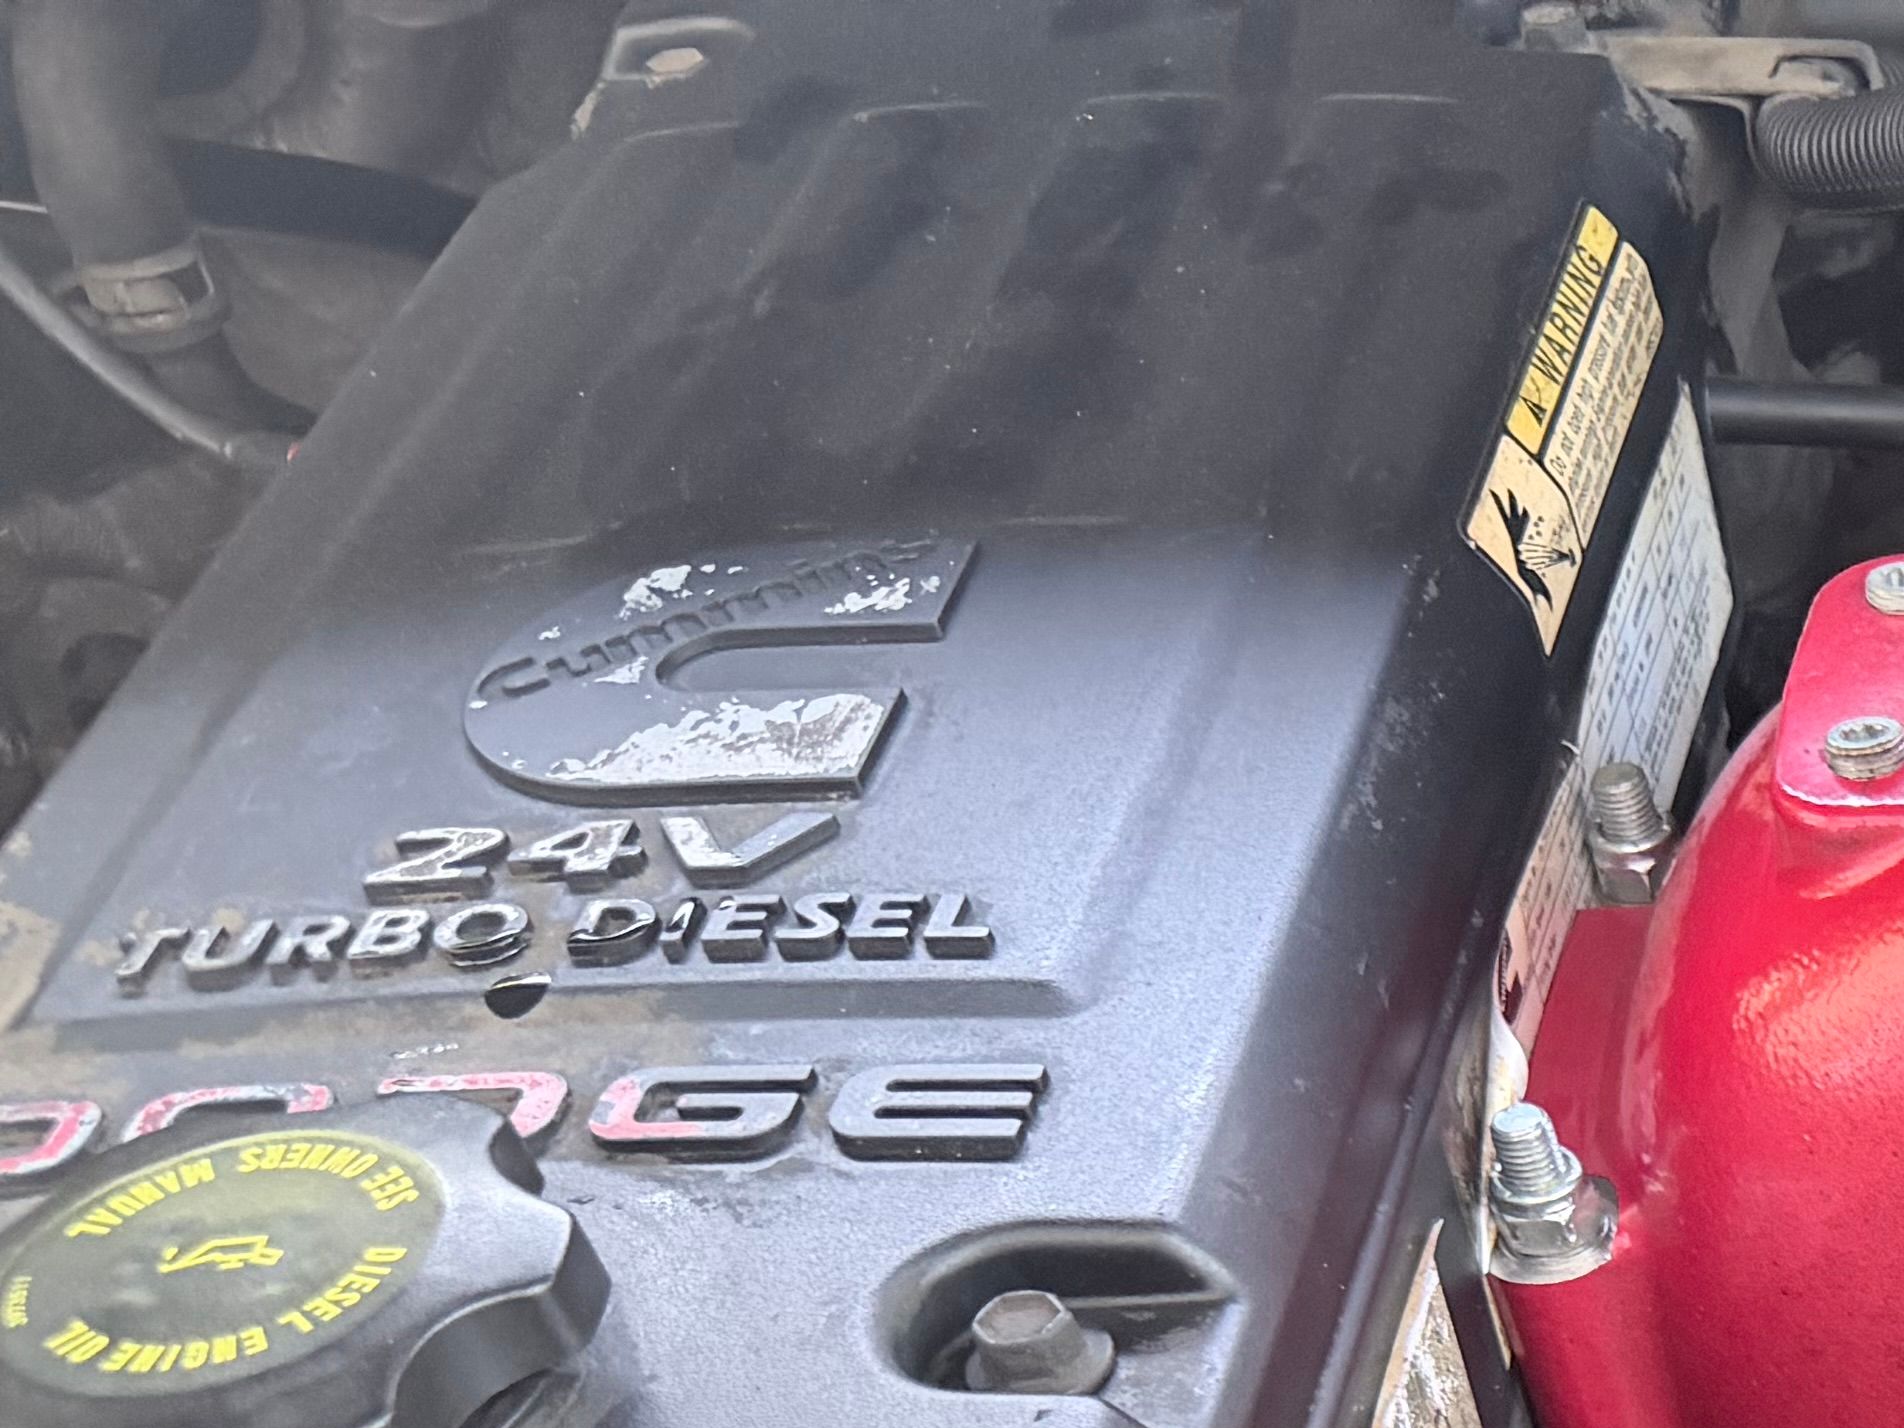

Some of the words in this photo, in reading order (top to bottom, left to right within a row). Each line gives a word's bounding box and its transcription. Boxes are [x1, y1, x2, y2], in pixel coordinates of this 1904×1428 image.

[1530, 243, 1603, 385] WARNING
[363, 813, 841, 903] 24V
[115, 901, 534, 998] TURBO
[568, 890, 998, 964] DIESEL
[64, 1159, 216, 1238] MANUAL
[238, 1142, 379, 1179] OWNERS
[359, 1166, 420, 1211] SEE
[276, 1247, 407, 1334] DIESEL
[42, 1318, 110, 1363] OIL
[101, 1326, 269, 1372] ENGINE
